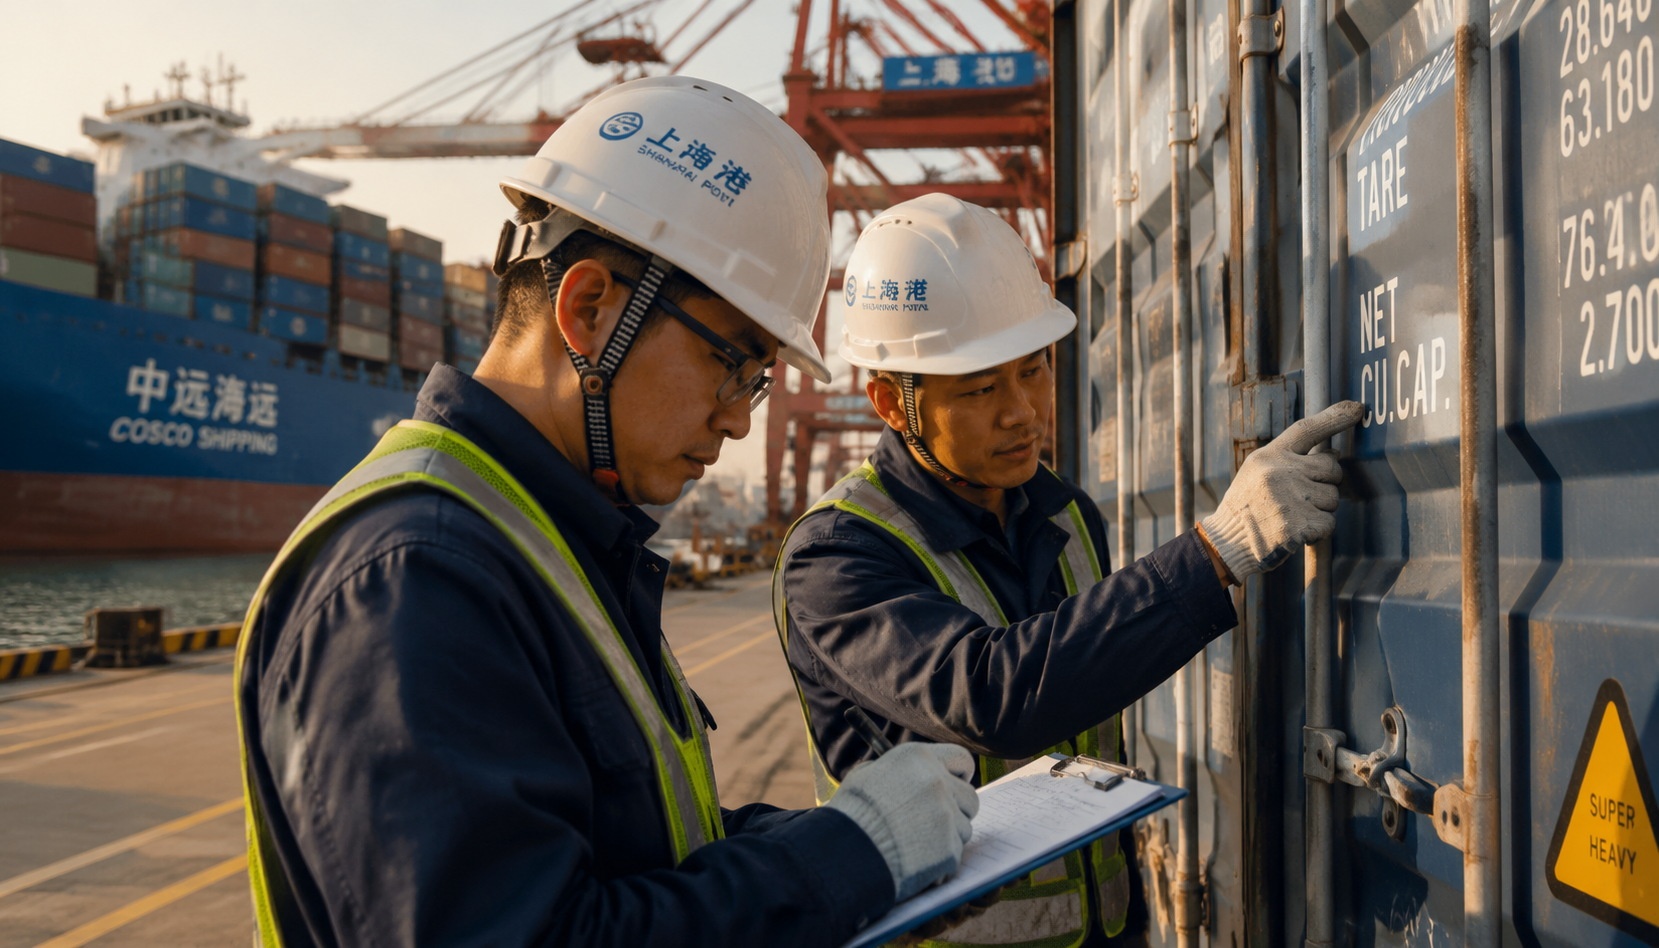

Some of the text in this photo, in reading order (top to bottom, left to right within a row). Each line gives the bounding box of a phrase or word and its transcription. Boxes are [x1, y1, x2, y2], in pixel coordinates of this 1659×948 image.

[1560, 35, 1654, 158] 63.180
[646, 127, 752, 195] 上海港
[1357, 136, 1408, 231] TARE
[862, 279, 928, 301] 上海港
[1360, 276, 1398, 354] NET
[1580, 277, 1659, 377] 2.700
[1361, 337, 1450, 429] CU.CAP.
[108, 416, 279, 457] COSCO SHIPPING
[1590, 792, 1635, 830] SUPER
[1589, 834, 1637, 876] HEAVY
